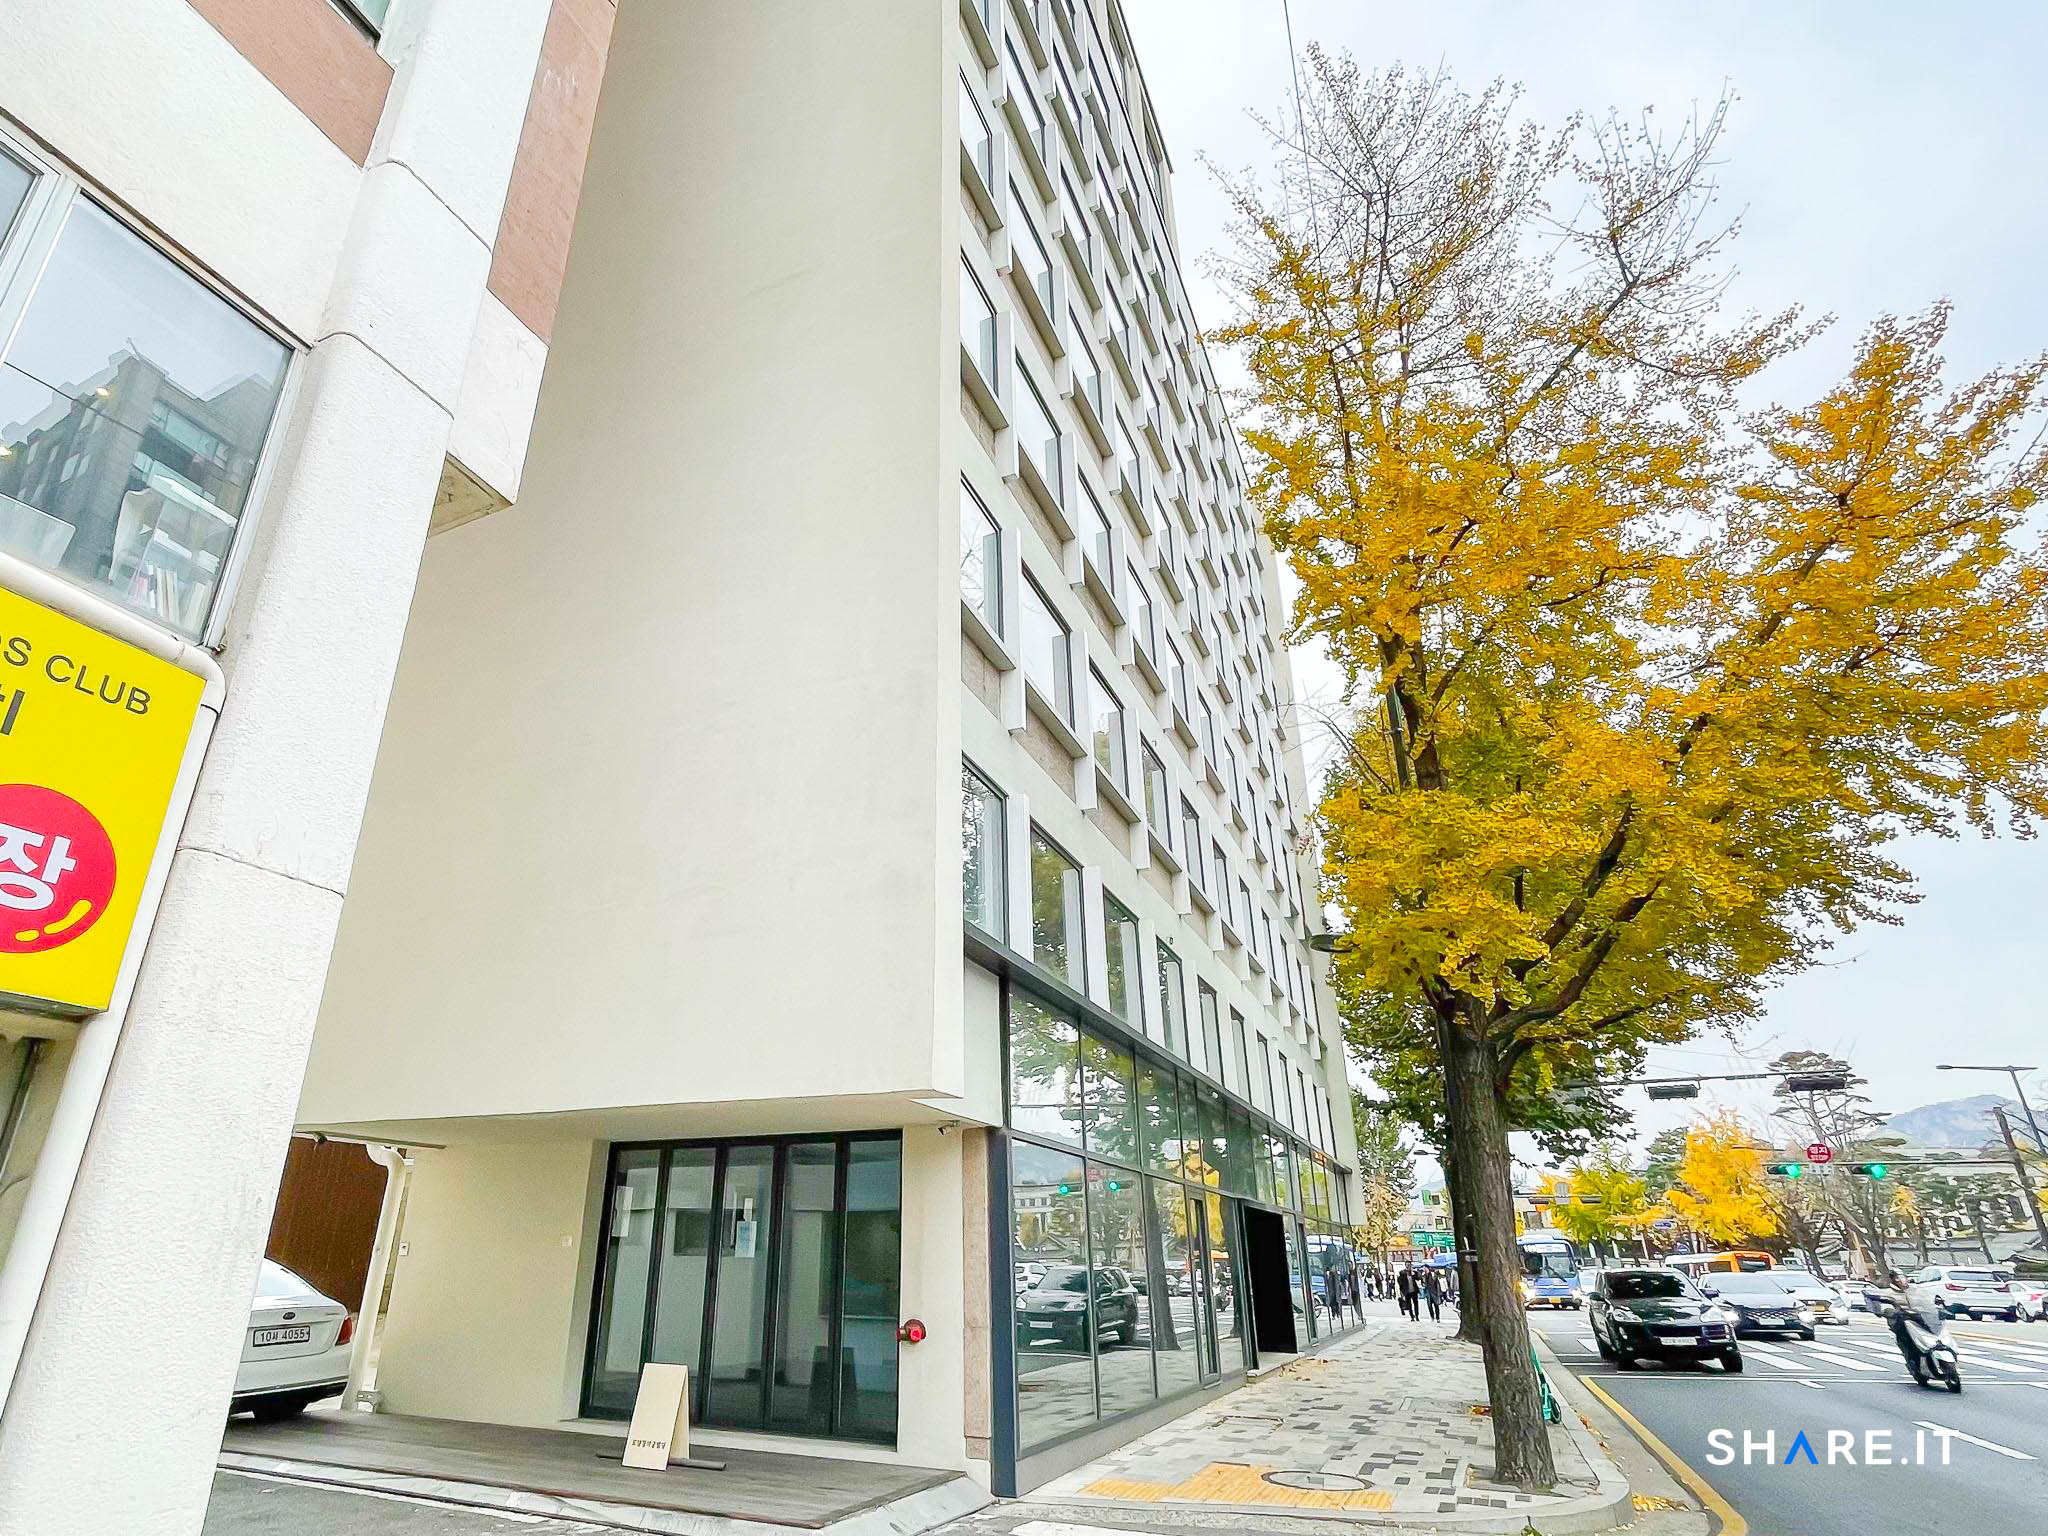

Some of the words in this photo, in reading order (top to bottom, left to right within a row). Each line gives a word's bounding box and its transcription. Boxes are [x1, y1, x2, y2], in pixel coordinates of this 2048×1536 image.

[0, 636, 31, 666] S
[46, 654, 151, 715] CLUB
[0, 822, 77, 911] 장
[282, 1328, 305, 1340] 4055
